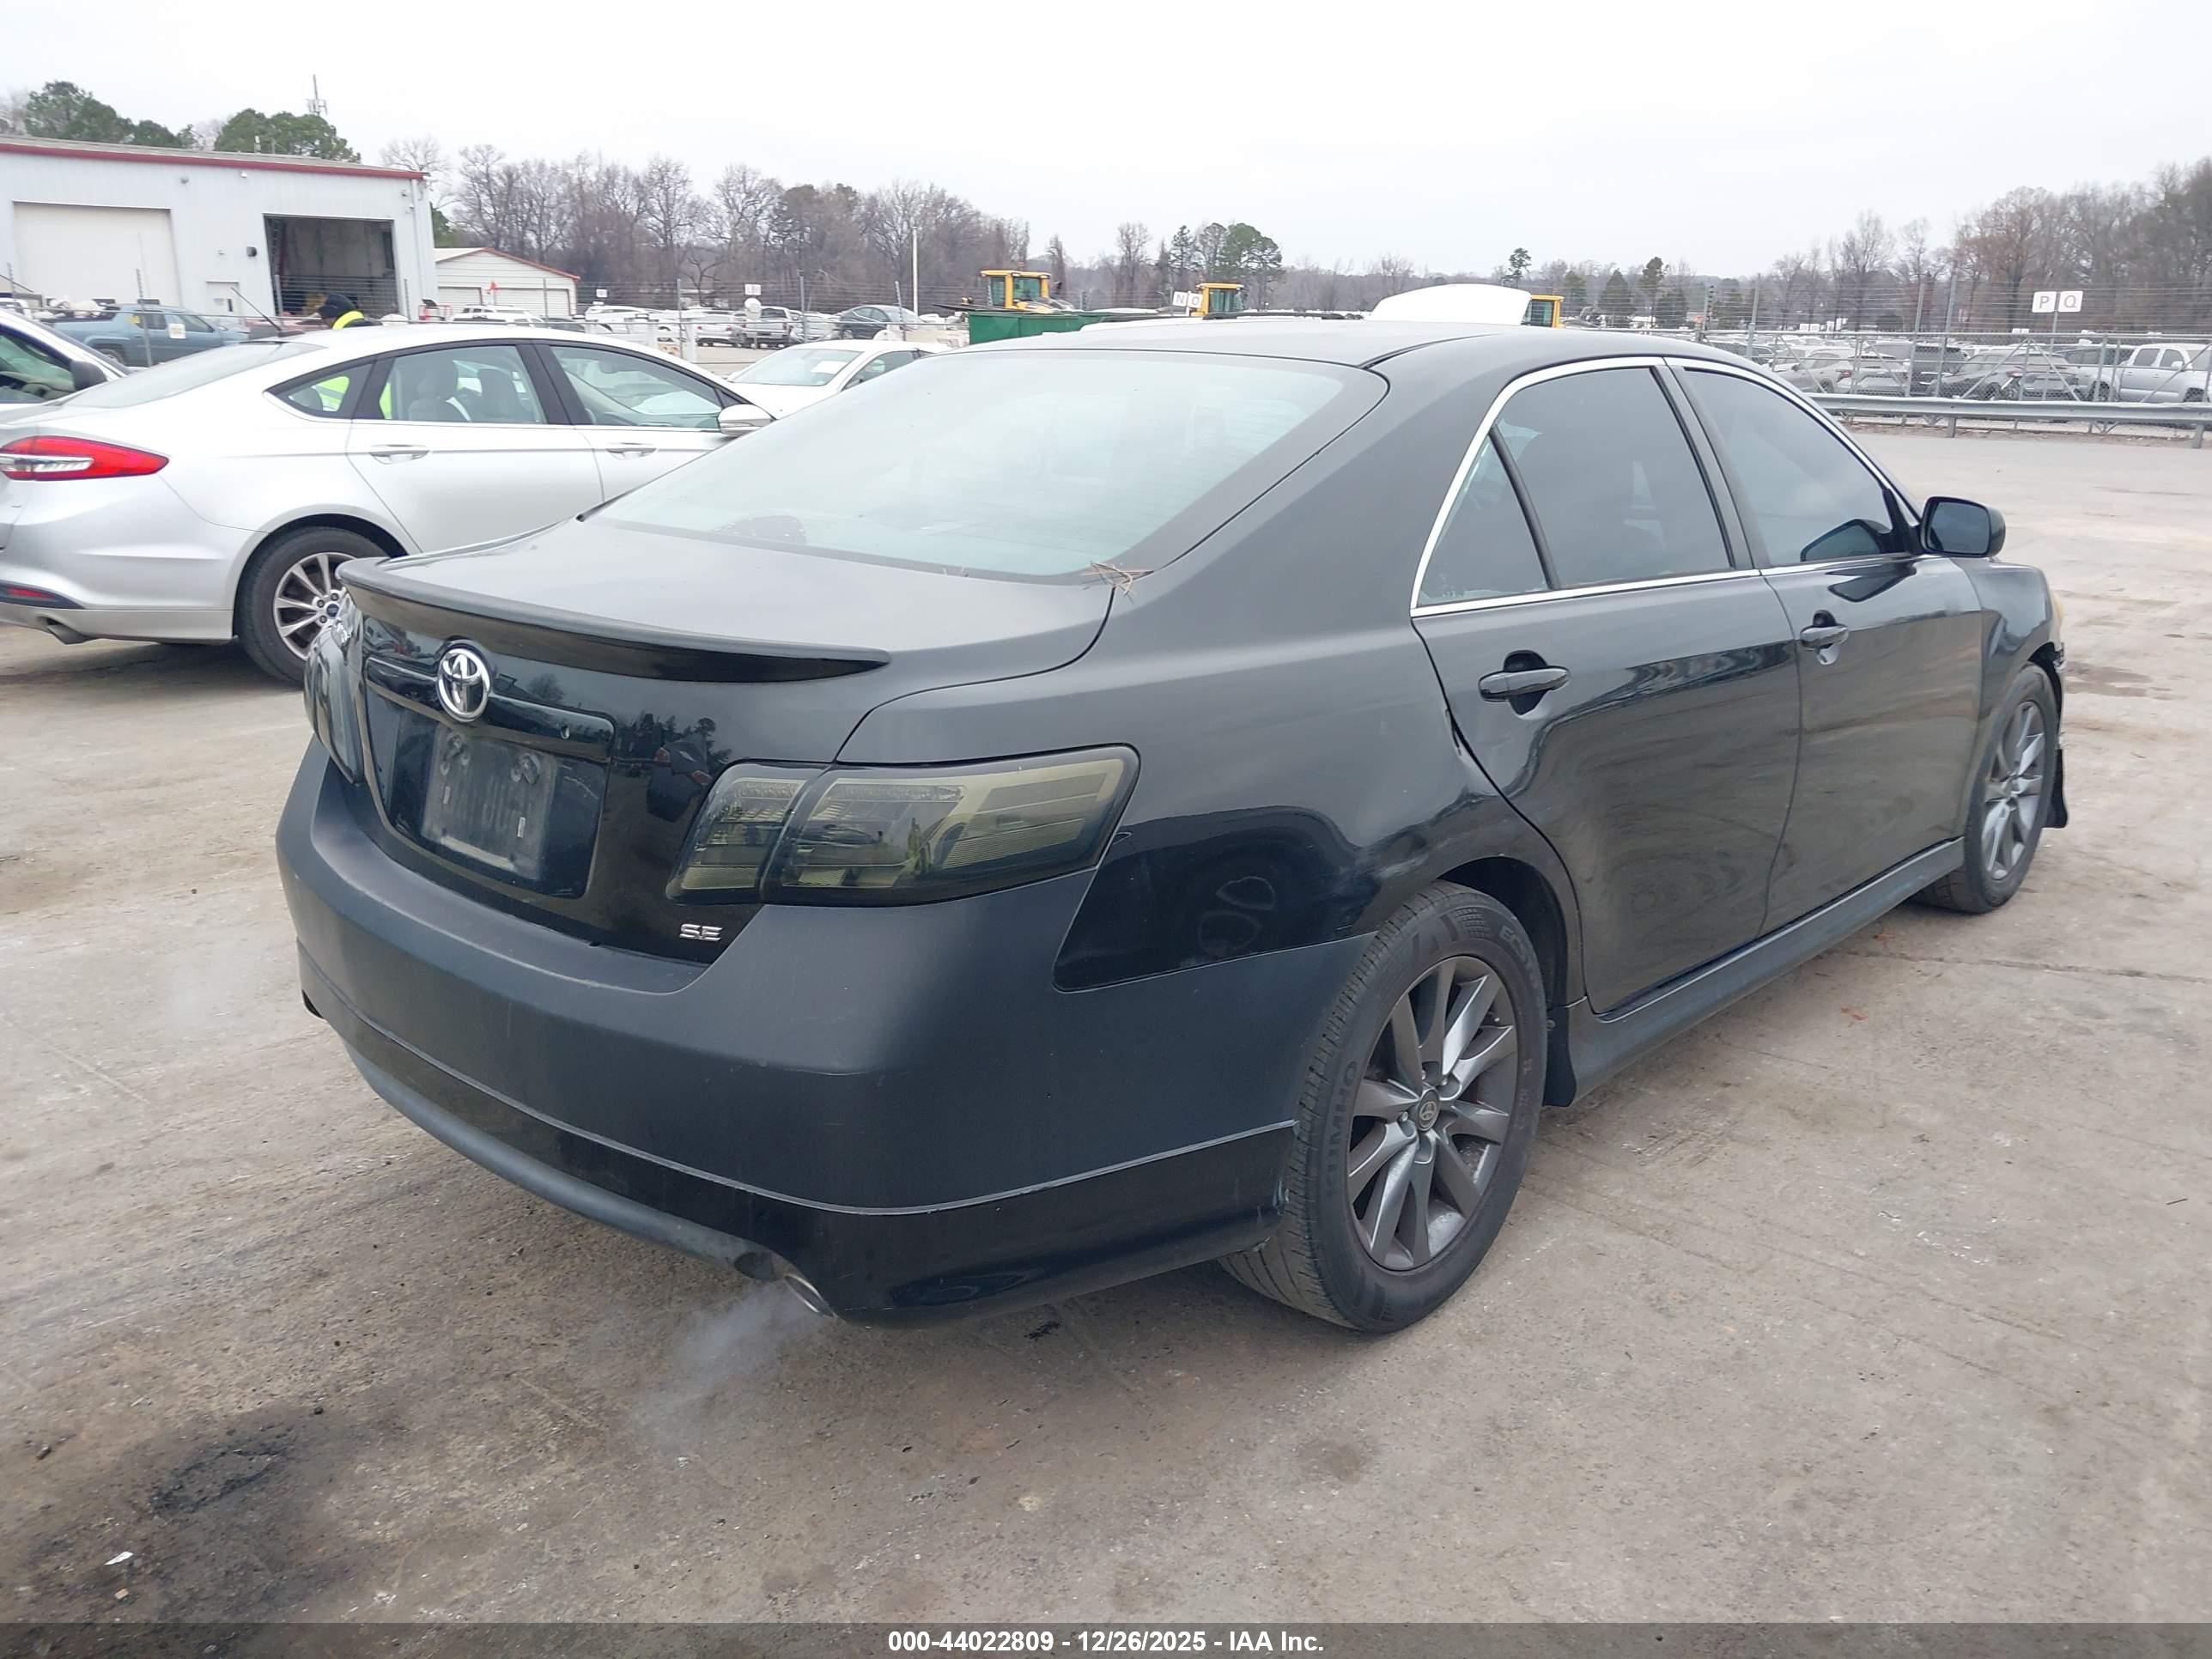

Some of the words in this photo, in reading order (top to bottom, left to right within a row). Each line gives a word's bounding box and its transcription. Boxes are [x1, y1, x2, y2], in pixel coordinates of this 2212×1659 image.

[2038, 295, 2051, 310] P
[2063, 294, 2077, 308] Q
[678, 923, 724, 941] SE
[1324, 1060, 1358, 1198] KUMHO
